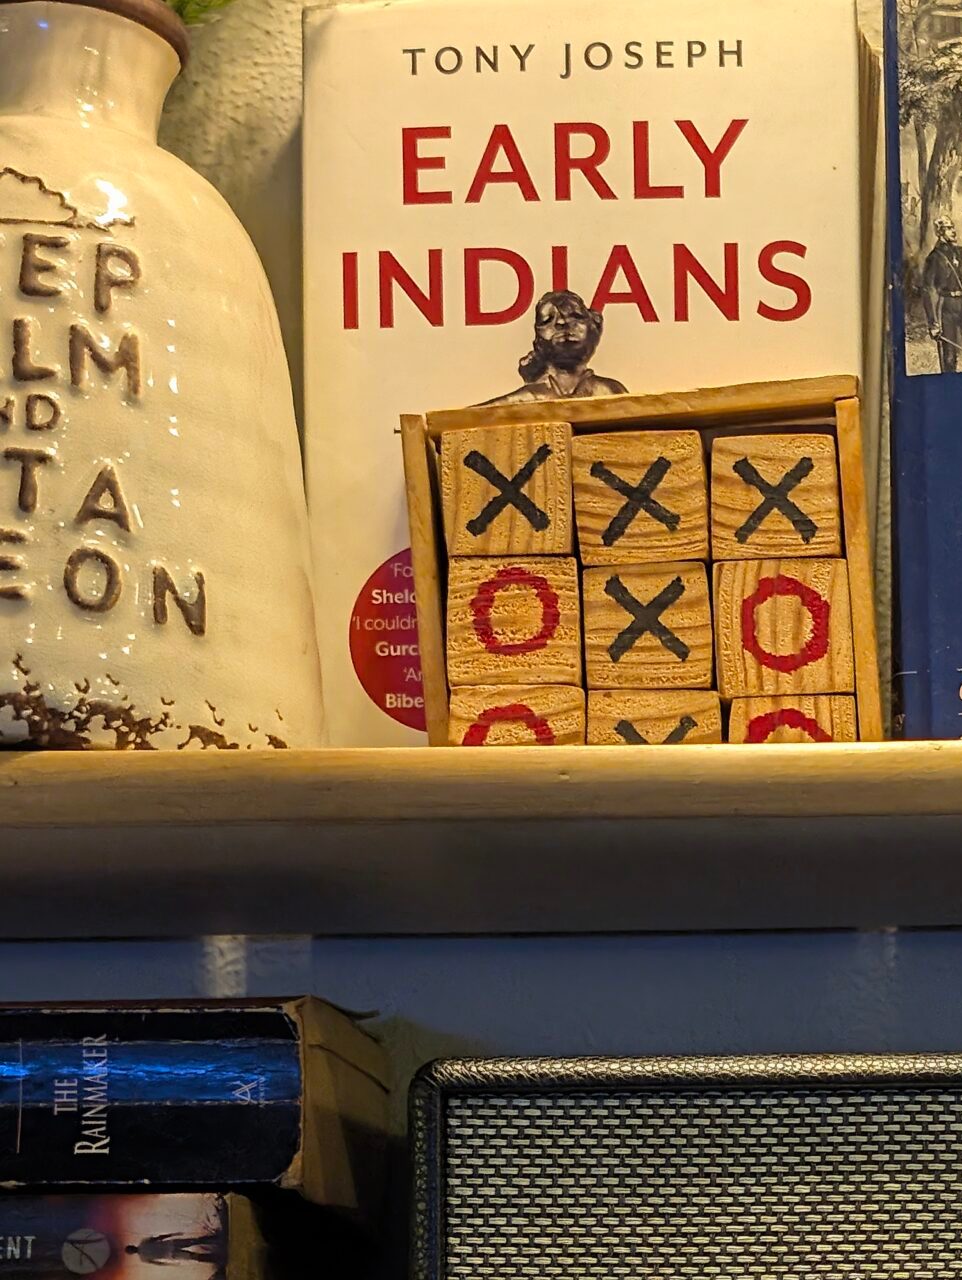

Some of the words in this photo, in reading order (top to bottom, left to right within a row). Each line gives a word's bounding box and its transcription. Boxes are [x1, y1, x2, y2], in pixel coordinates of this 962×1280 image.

[403, 43, 535, 76] TONY
[560, 40, 744, 79] JOSEPH
[402, 118, 750, 205] EARLY
[341, 240, 813, 330] INDIANS
[53, 1078, 79, 1117] THE
[72, 1032, 112, 1157] RAINMAKER
